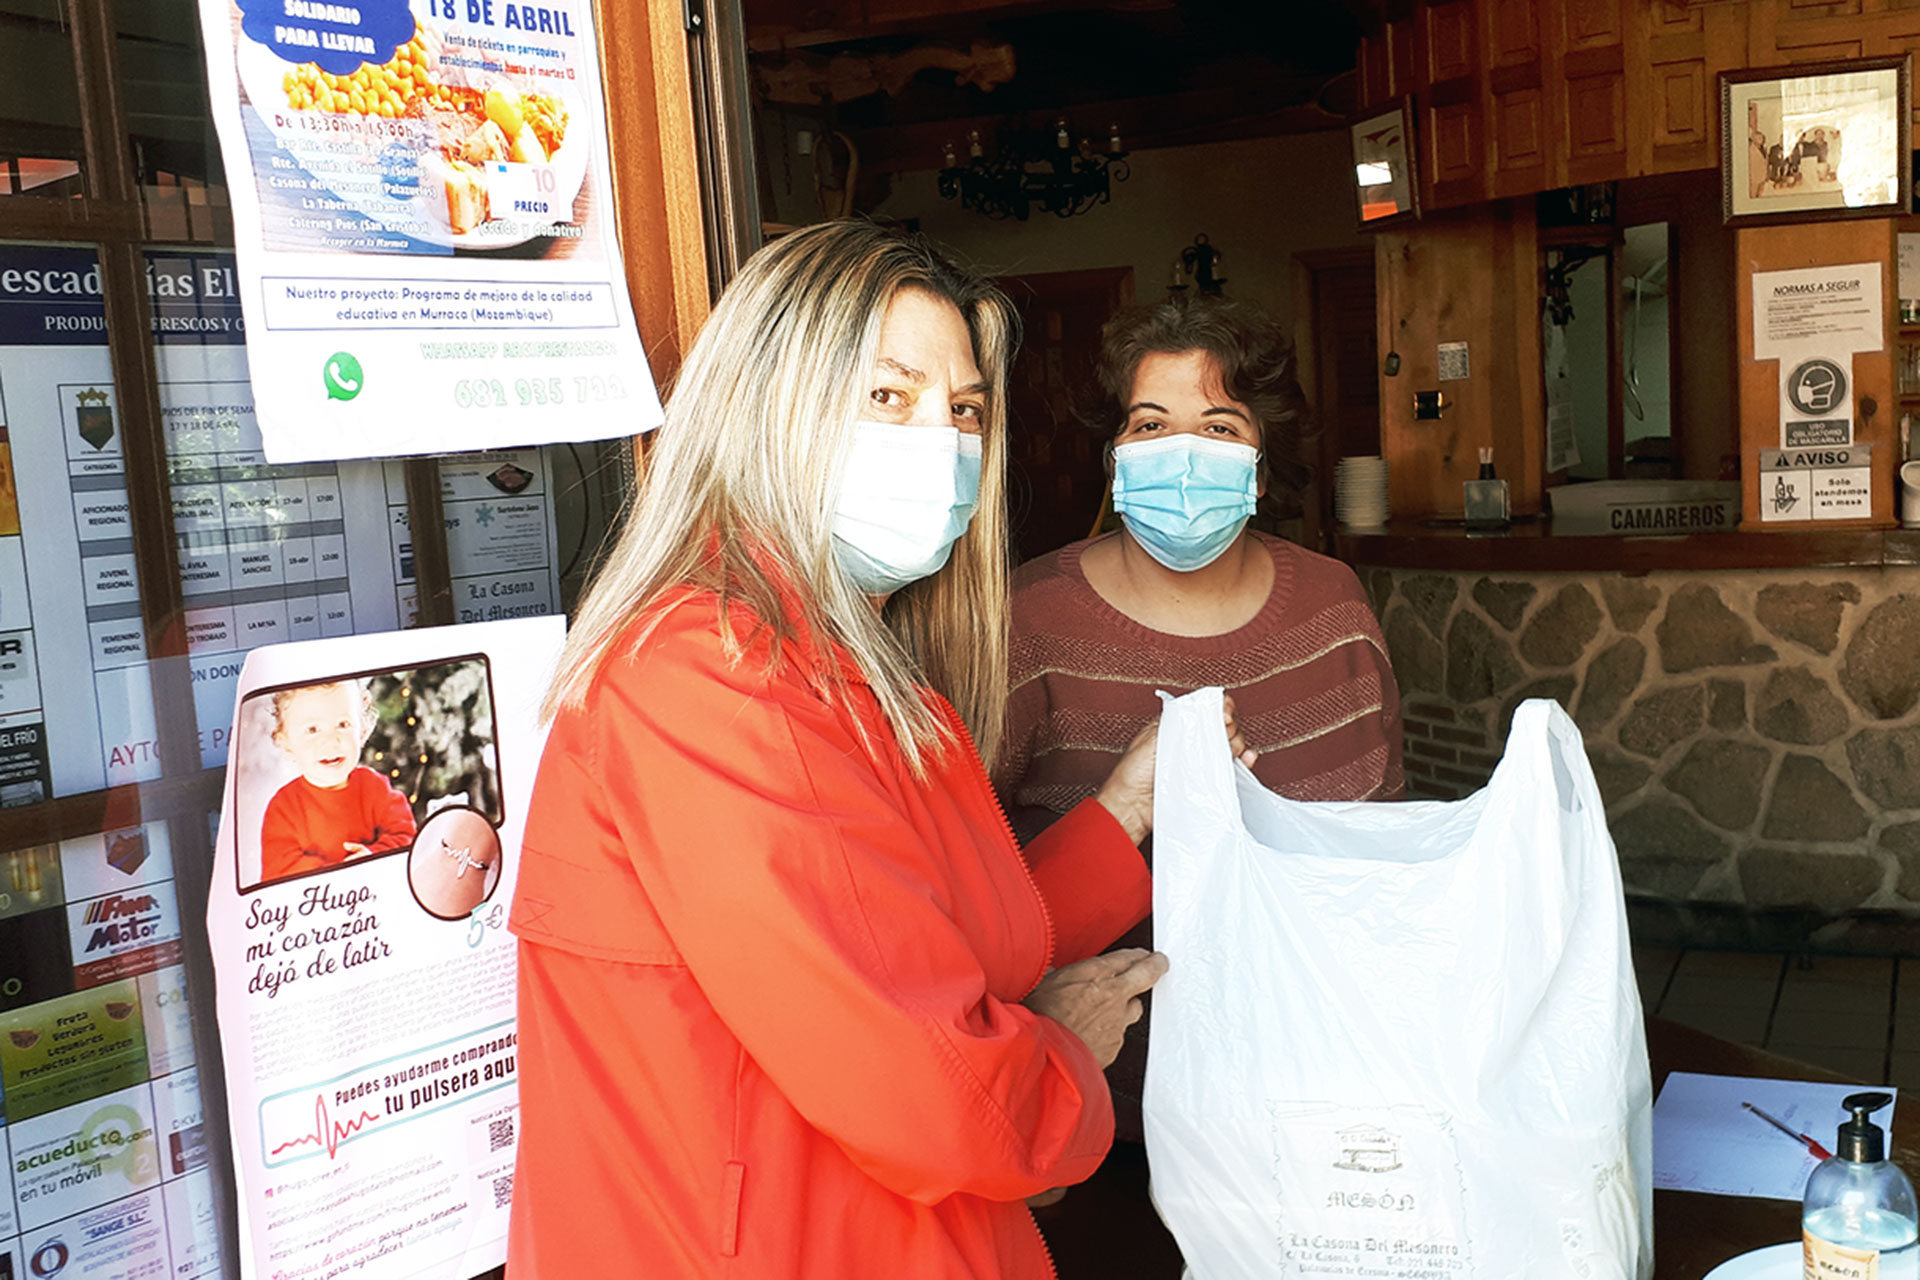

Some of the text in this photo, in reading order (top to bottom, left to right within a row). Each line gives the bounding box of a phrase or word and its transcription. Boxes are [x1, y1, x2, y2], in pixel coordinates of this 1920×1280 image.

[284, 0, 361, 25] SOLIDARIO
[430, 0, 575, 37] 18 DE ABRIL
[275, 26, 376, 54] PARA LLEVAR
[467, 36, 477, 48] de
[478, 37, 504, 51] tickets
[506, 43, 517, 53] en
[518, 45, 560, 59] parroquias
[439, 54, 503, 72] establecimientos
[505, 59, 527, 75] hasta
[275, 114, 293, 129] De
[269, 176, 307, 190] Casona
[531, 169, 556, 193] 10
[514, 200, 549, 213] PRECIO
[289, 216, 333, 233] Catering
[203, 267, 236, 298] El
[1773, 279, 1861, 296] NORMAS A SEGUIR
[286, 286, 593, 303] Nuestro proyecto: Programa de mejora de la calidad
[151, 316, 219, 332] FRESCOS
[219, 317, 232, 332] Y
[336, 307, 398, 320] educativa
[402, 310, 417, 320] en
[471, 308, 553, 322] (Mozambique)
[455, 378, 508, 409] 682
[514, 377, 564, 406] 935
[1799, 436, 1848, 446] MASCARILLA
[1793, 451, 1850, 467] AVISO
[1814, 488, 1868, 498] atendemos
[1828, 478, 1851, 487] Solo
[1836, 499, 1863, 507] mesa
[88, 516, 127, 526] REGIONAL
[1610, 504, 1726, 530] CAMAREROS
[97, 580, 135, 591] REGIONAL
[467, 580, 535, 600] La Casona
[460, 601, 548, 624] Del Mesonero
[104, 643, 141, 655] REGIONAL
[245, 884, 378, 932] Soy Hugo,
[84, 916, 161, 954] Motor
[466, 903, 504, 949] 5€
[246, 911, 381, 964] mi corazón
[248, 936, 394, 999] dejó de latir
[56, 1011, 89, 1027] Fruta
[335, 1056, 450, 1107] Puedes ayudarme
[385, 1054, 516, 1115] tu pulsera aqu
[19, 1162, 103, 1203] en tu móvil
[321, 1253, 333, 1268] de
[335, 1238, 377, 1261] corazón
[378, 1223, 414, 1246] porque
[415, 1217, 429, 1228] no
[430, 1200, 468, 1222] tenemos
[352, 1240, 404, 1269] agradecer
[1312, 1235, 1360, 1251] Casona
[1392, 1238, 1459, 1256] Mesonero
